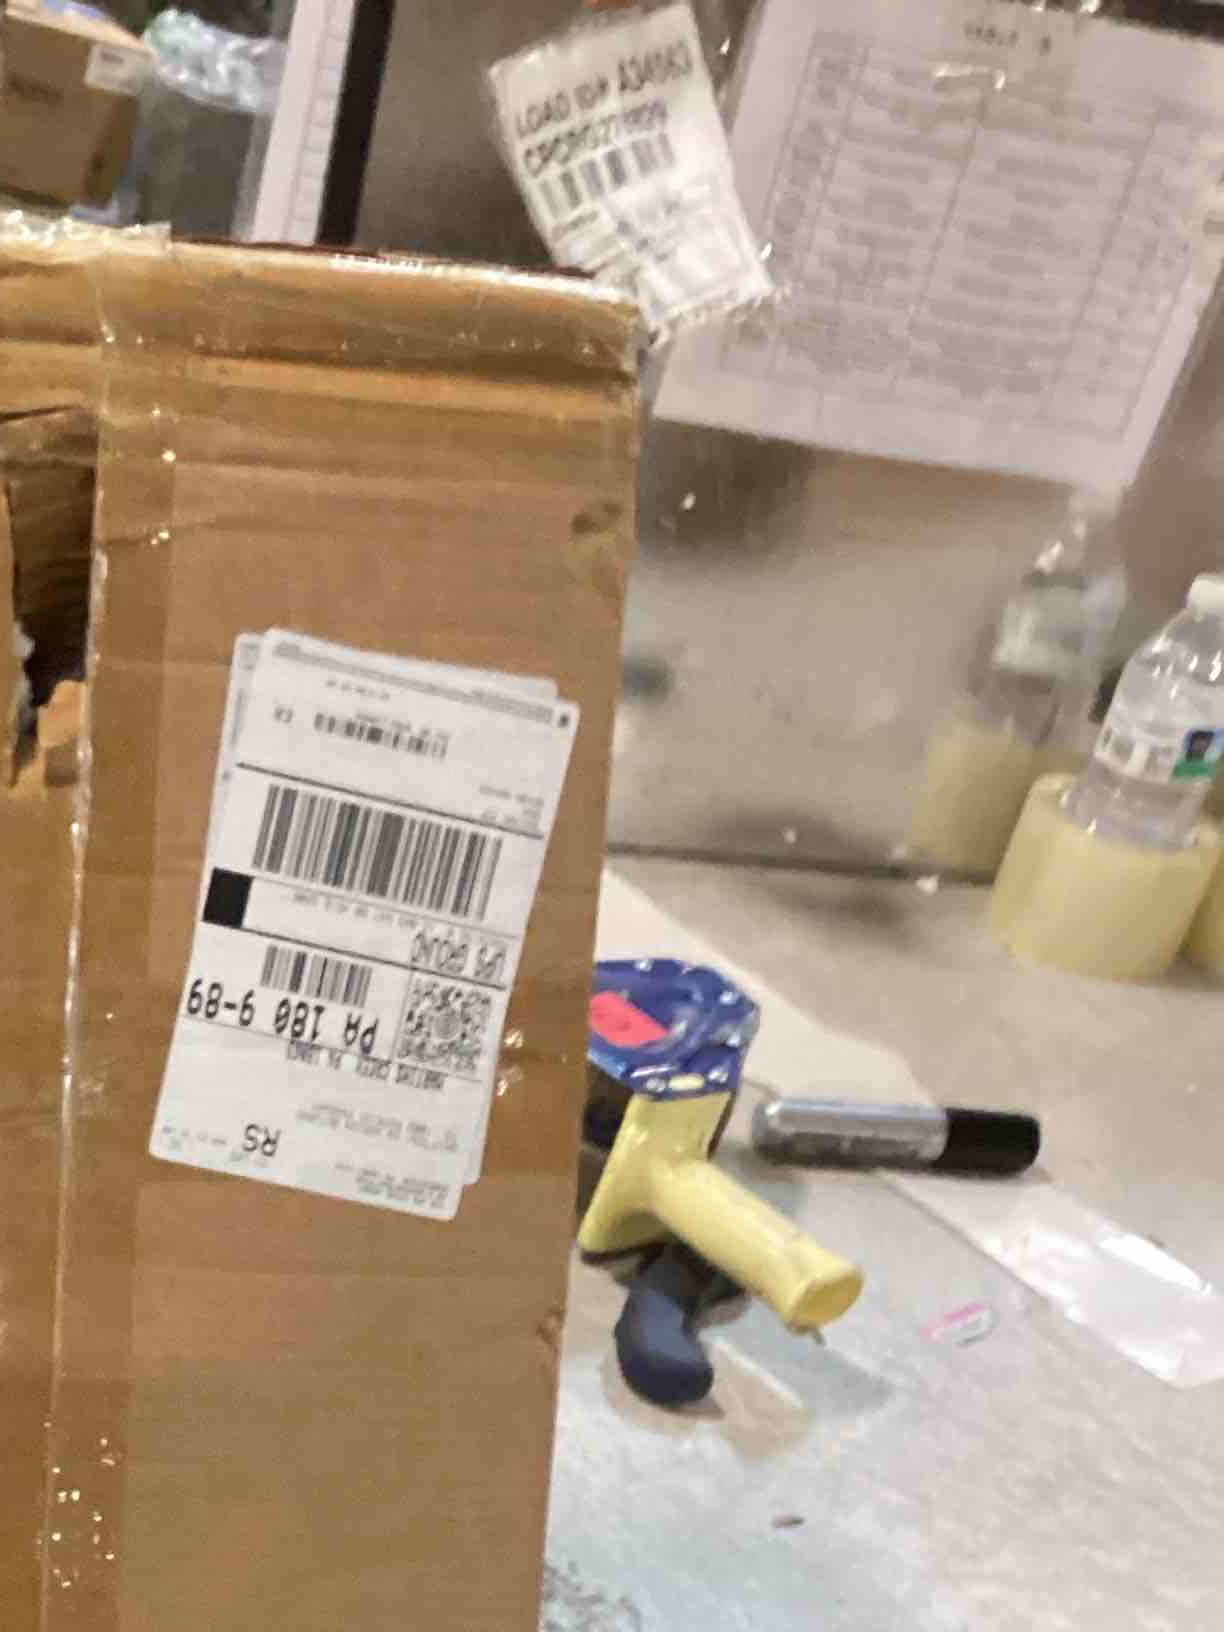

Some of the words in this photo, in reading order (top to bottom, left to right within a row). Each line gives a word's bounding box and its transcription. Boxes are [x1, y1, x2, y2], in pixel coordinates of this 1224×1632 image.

[185, 978, 257, 1027] 9-89
[273, 998, 325, 1041] 180
[344, 1013, 378, 1055] PA
[243, 1122, 281, 1158] RS
